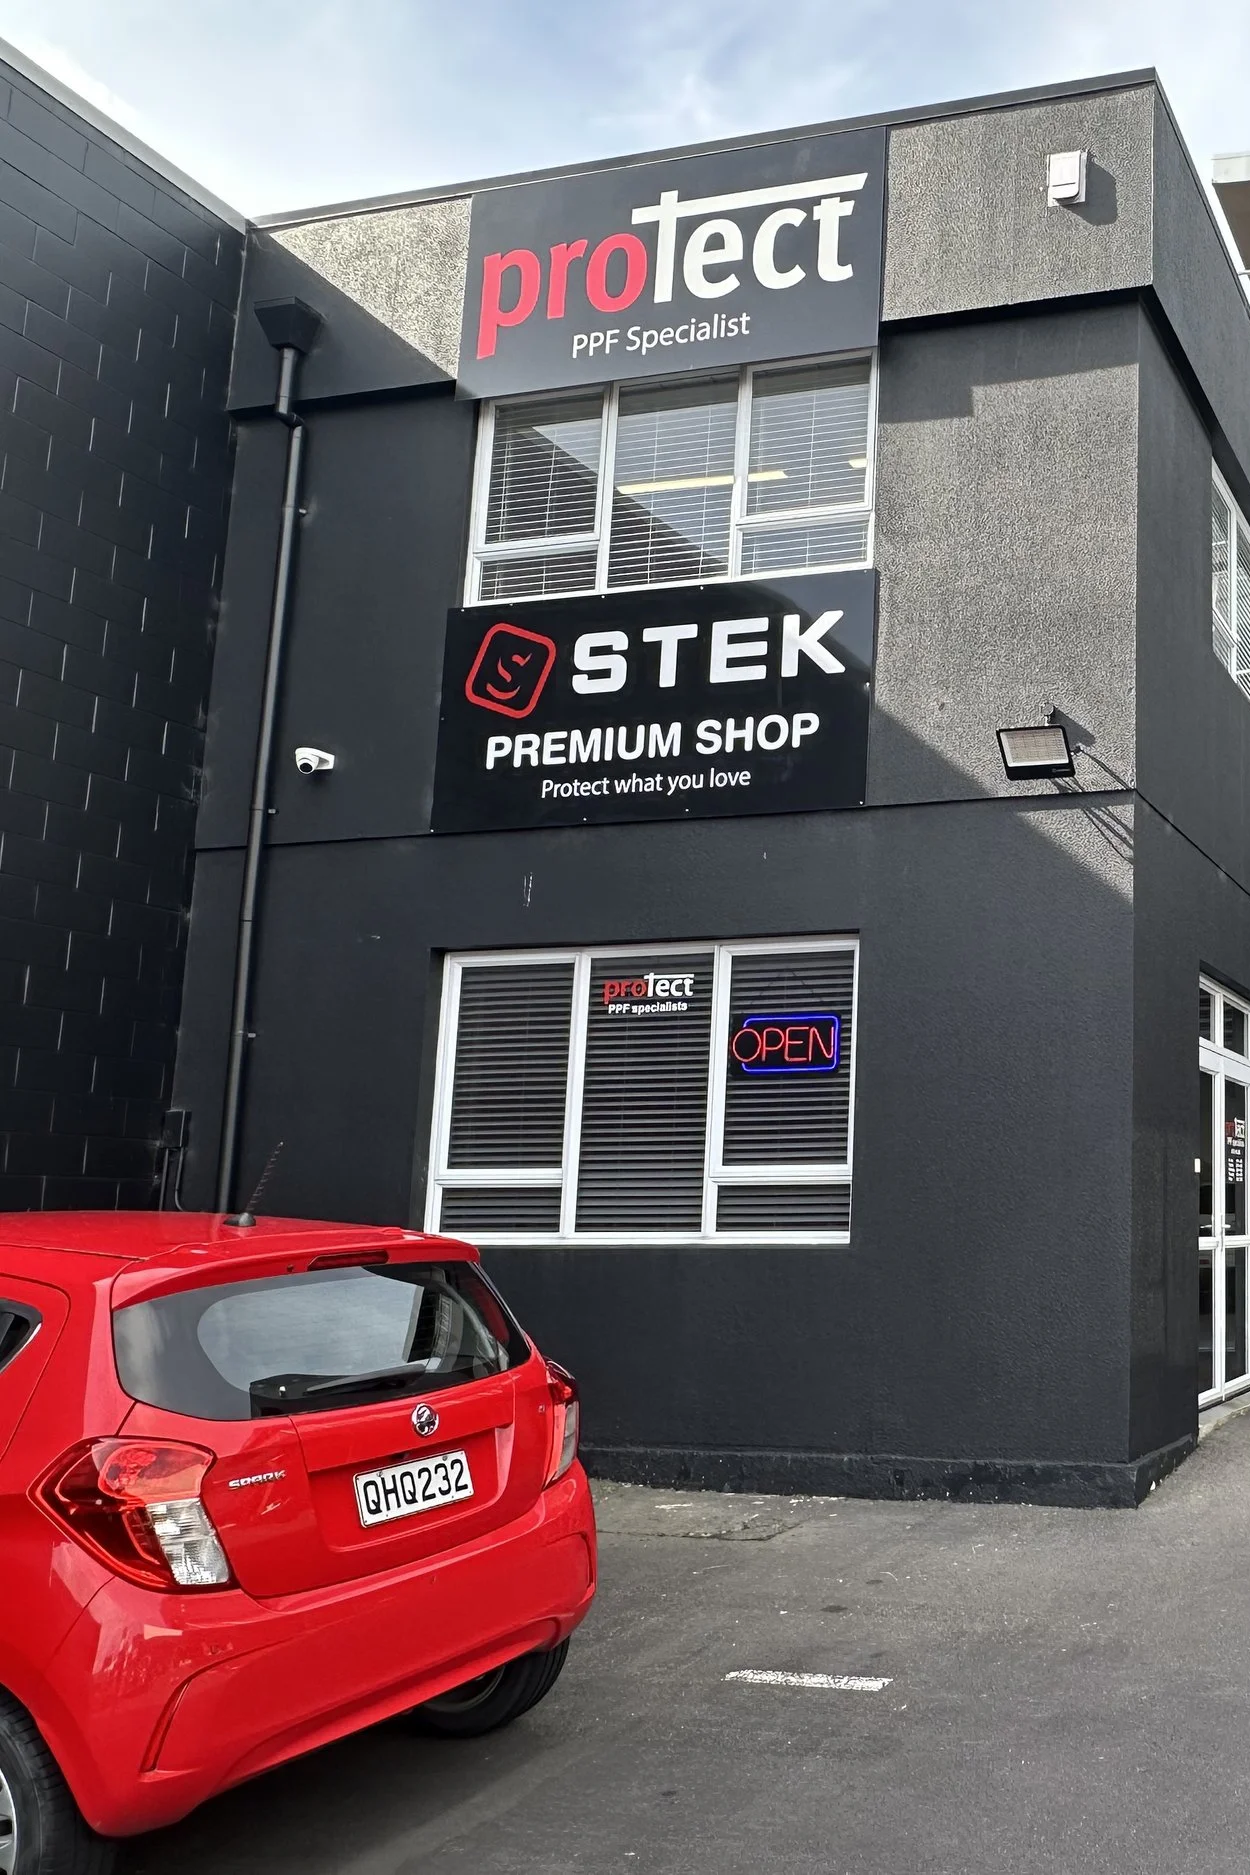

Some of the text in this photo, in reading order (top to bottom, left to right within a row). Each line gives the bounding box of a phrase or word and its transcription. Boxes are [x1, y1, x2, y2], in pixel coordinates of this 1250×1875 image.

[572, 312, 750, 358] PPF Specialist
[571, 610, 846, 695] STEK
[485, 712, 820, 770] PREMIUM SHOP
[541, 768, 751, 798] Protect what you love
[608, 1001, 688, 1015] PPF specialists
[732, 1026, 834, 1063] OPEN
[363, 1458, 469, 1515] QHQ232
